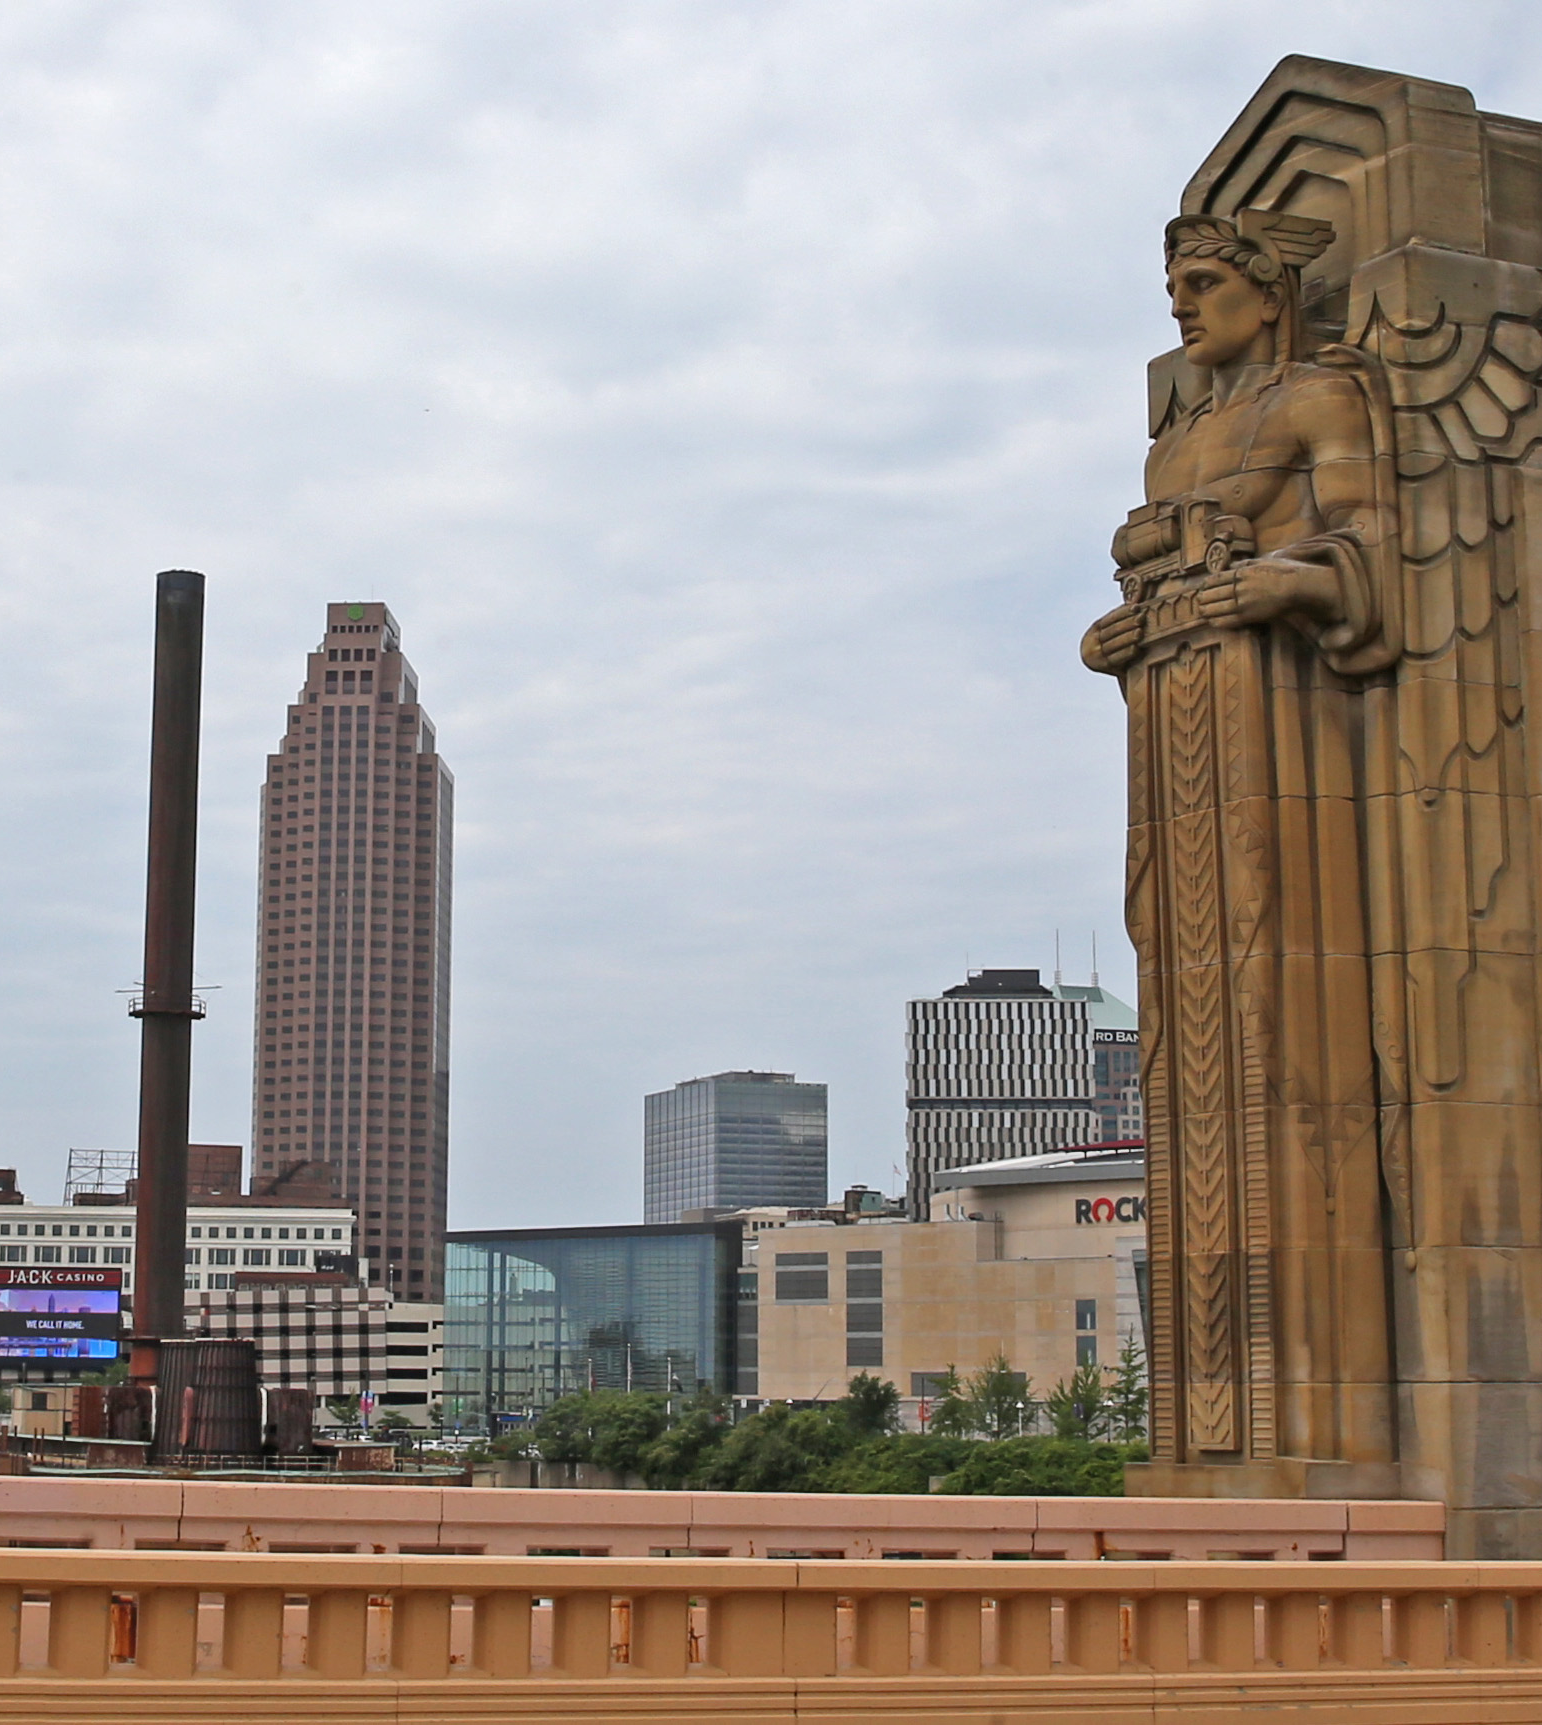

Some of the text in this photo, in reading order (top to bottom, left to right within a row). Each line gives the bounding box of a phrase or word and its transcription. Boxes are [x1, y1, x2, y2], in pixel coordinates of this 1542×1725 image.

[1093, 1031, 1113, 1042] RD
[1075, 1196, 1147, 1224] ROCK
[56, 1273, 105, 1282] CASINO
[26, 1319, 37, 1329] WE
[38, 1319, 54, 1329] CALL
[55, 1320, 62, 1329] IT
